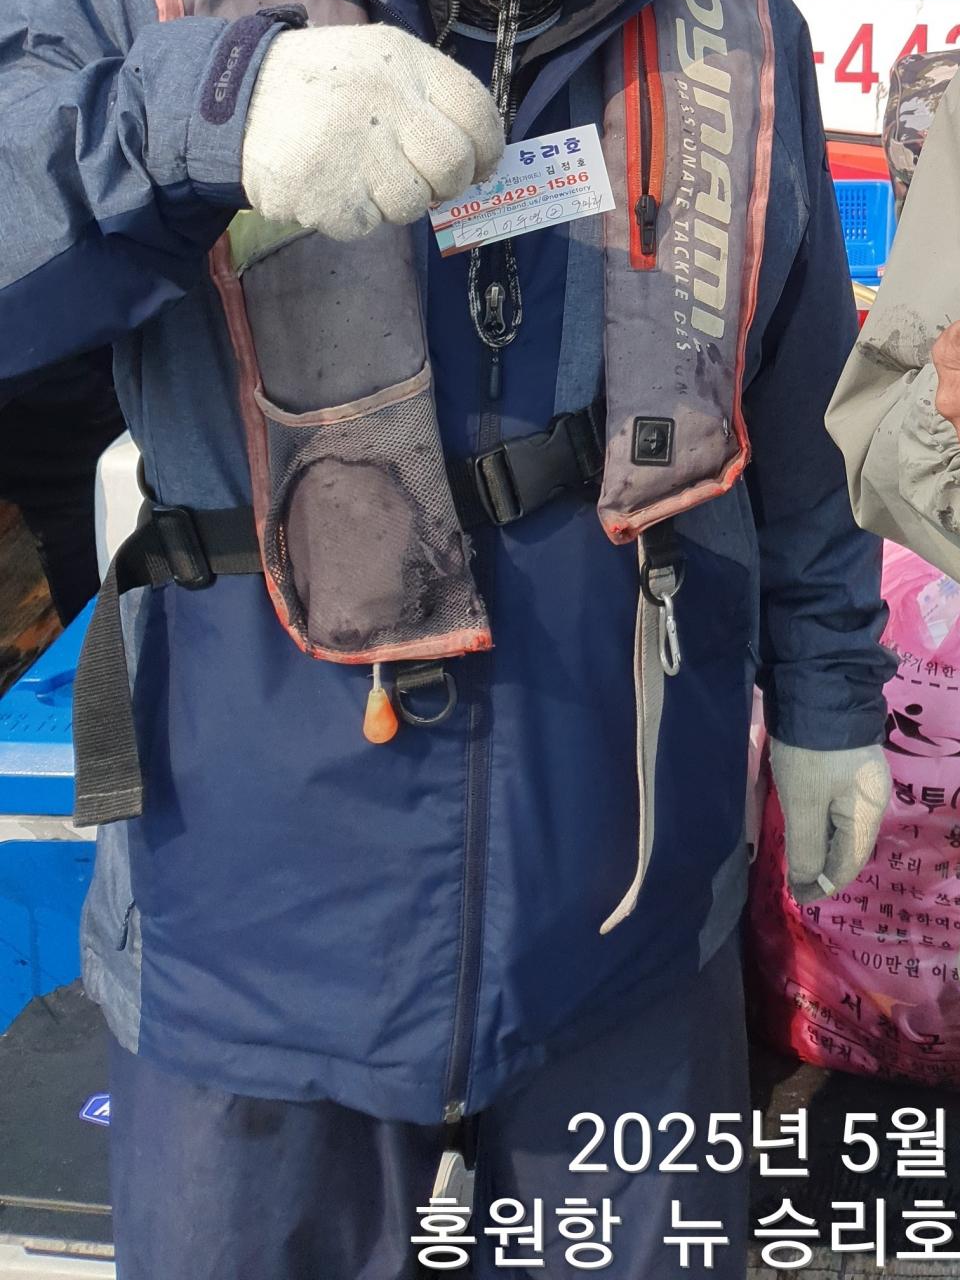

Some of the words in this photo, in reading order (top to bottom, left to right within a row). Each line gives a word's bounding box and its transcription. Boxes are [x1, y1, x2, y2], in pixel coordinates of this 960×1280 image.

[214, 45, 241, 102] EIDER
[519, 136, 582, 166] 승리호
[450, 170, 590, 219] 010-3429-1586
[672, 220, 690, 301] TACKLE
[888, 852, 921, 875] 분리
[890, 882, 926, 901] 타는
[831, 914, 865, 936] 다른
